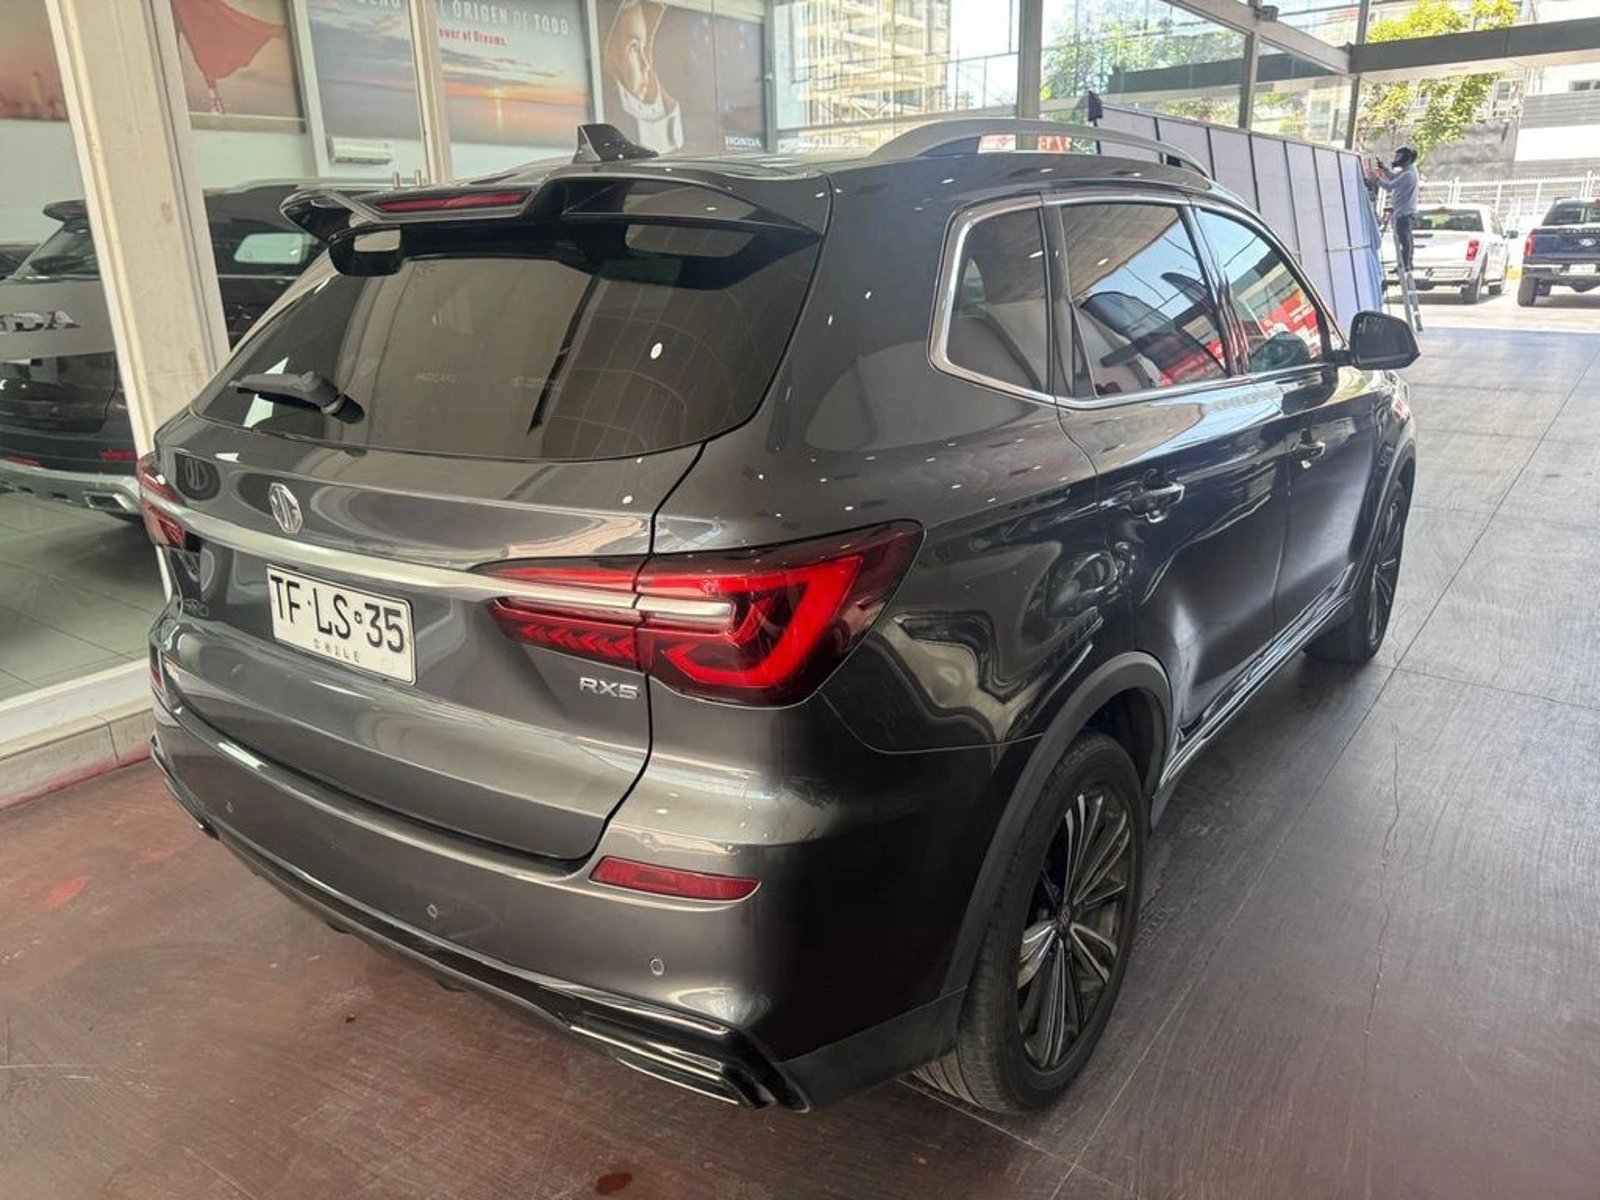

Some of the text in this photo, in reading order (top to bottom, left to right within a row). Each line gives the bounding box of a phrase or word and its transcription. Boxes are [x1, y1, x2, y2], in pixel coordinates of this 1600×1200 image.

[725, 136, 762, 148] HONDA
[313, 637, 360, 663] CHILE
[580, 676, 639, 700] RX5
